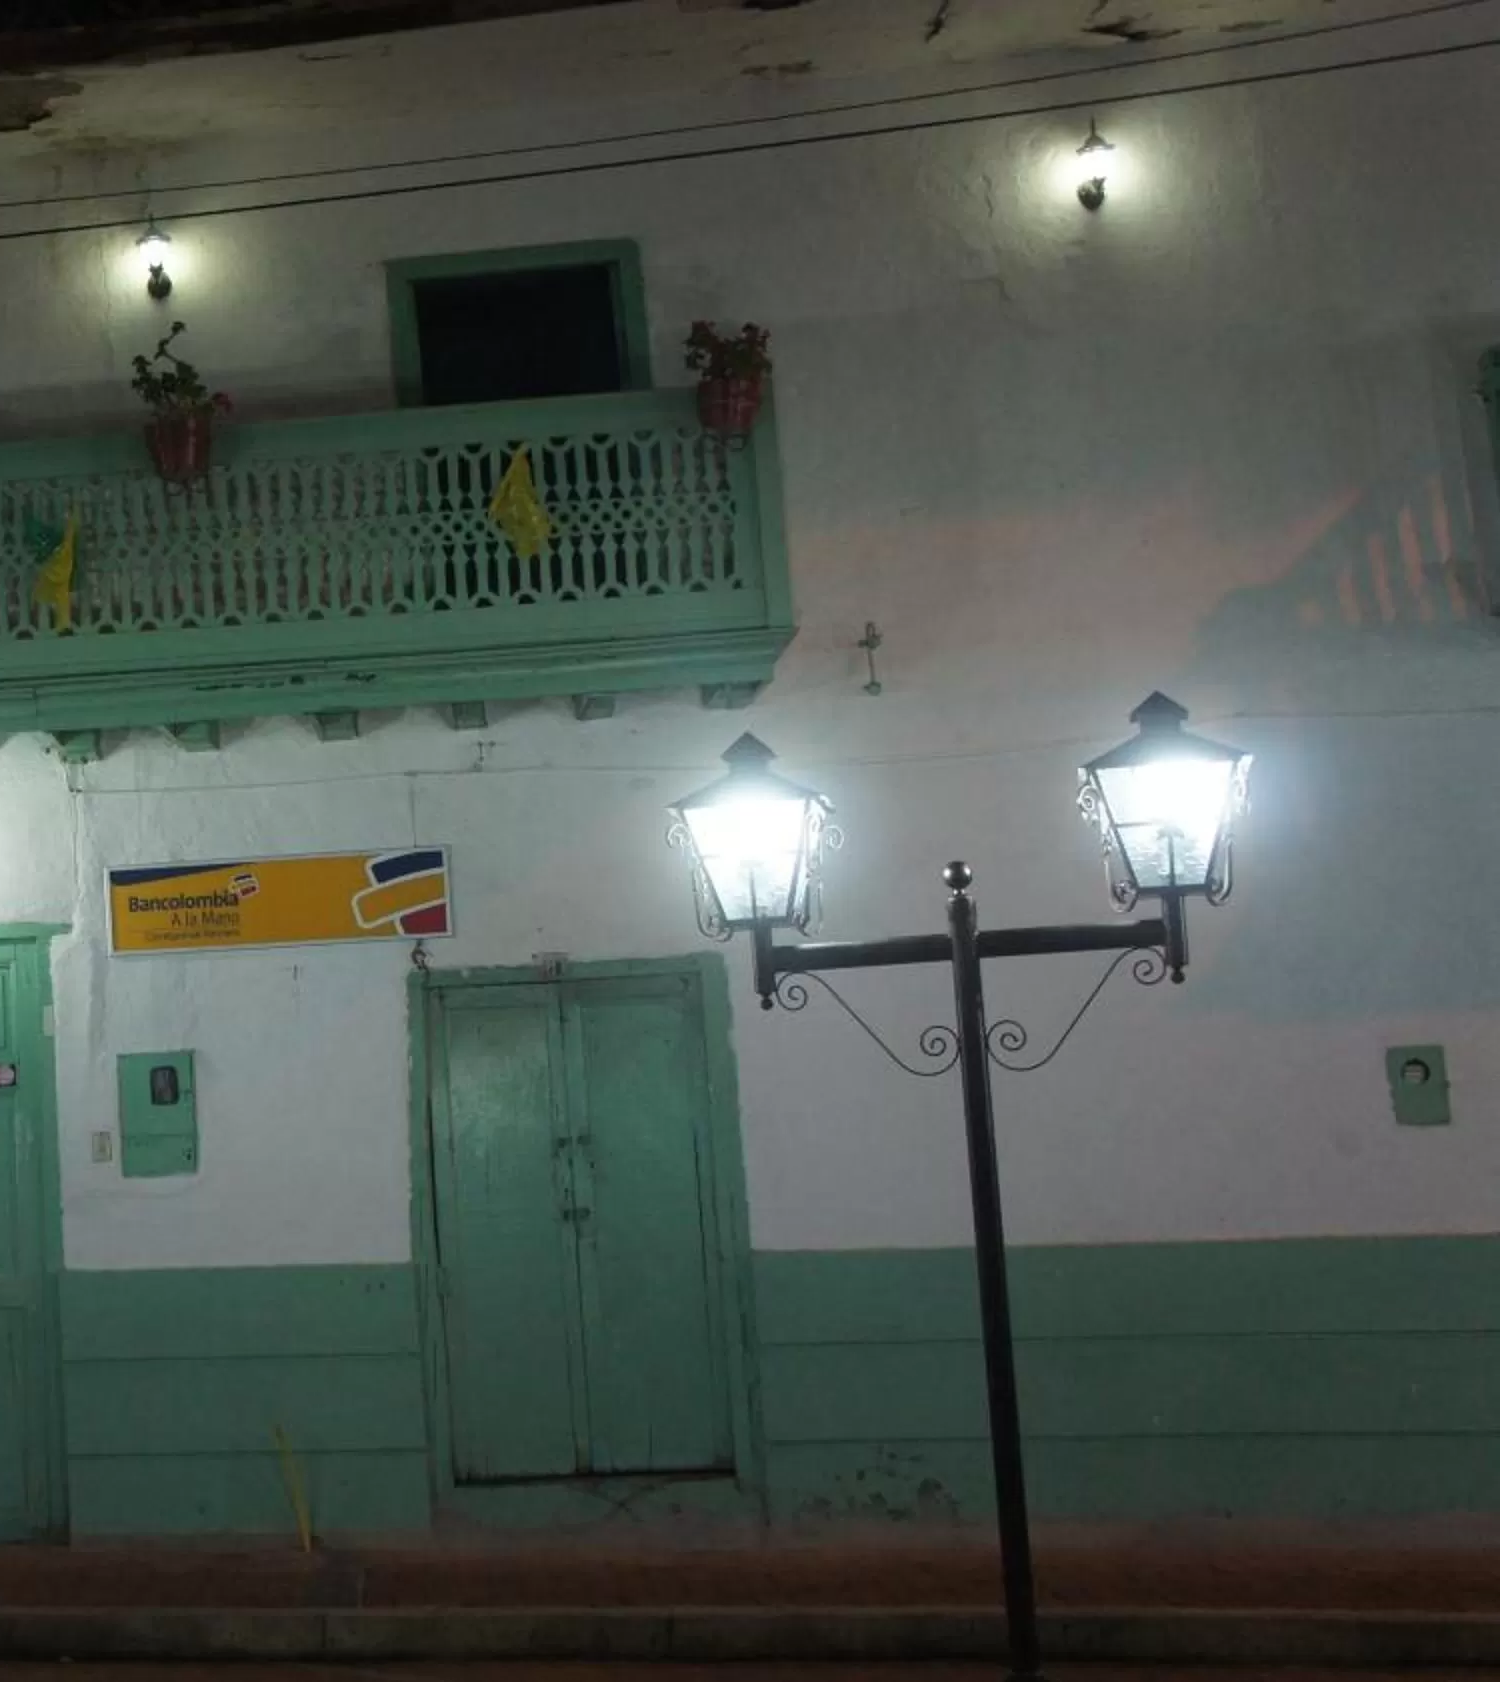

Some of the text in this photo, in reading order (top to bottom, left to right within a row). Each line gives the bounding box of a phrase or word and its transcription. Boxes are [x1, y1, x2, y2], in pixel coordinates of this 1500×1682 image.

[128, 889, 239, 913] Bancolombia
[171, 909, 241, 928] A la Mano
